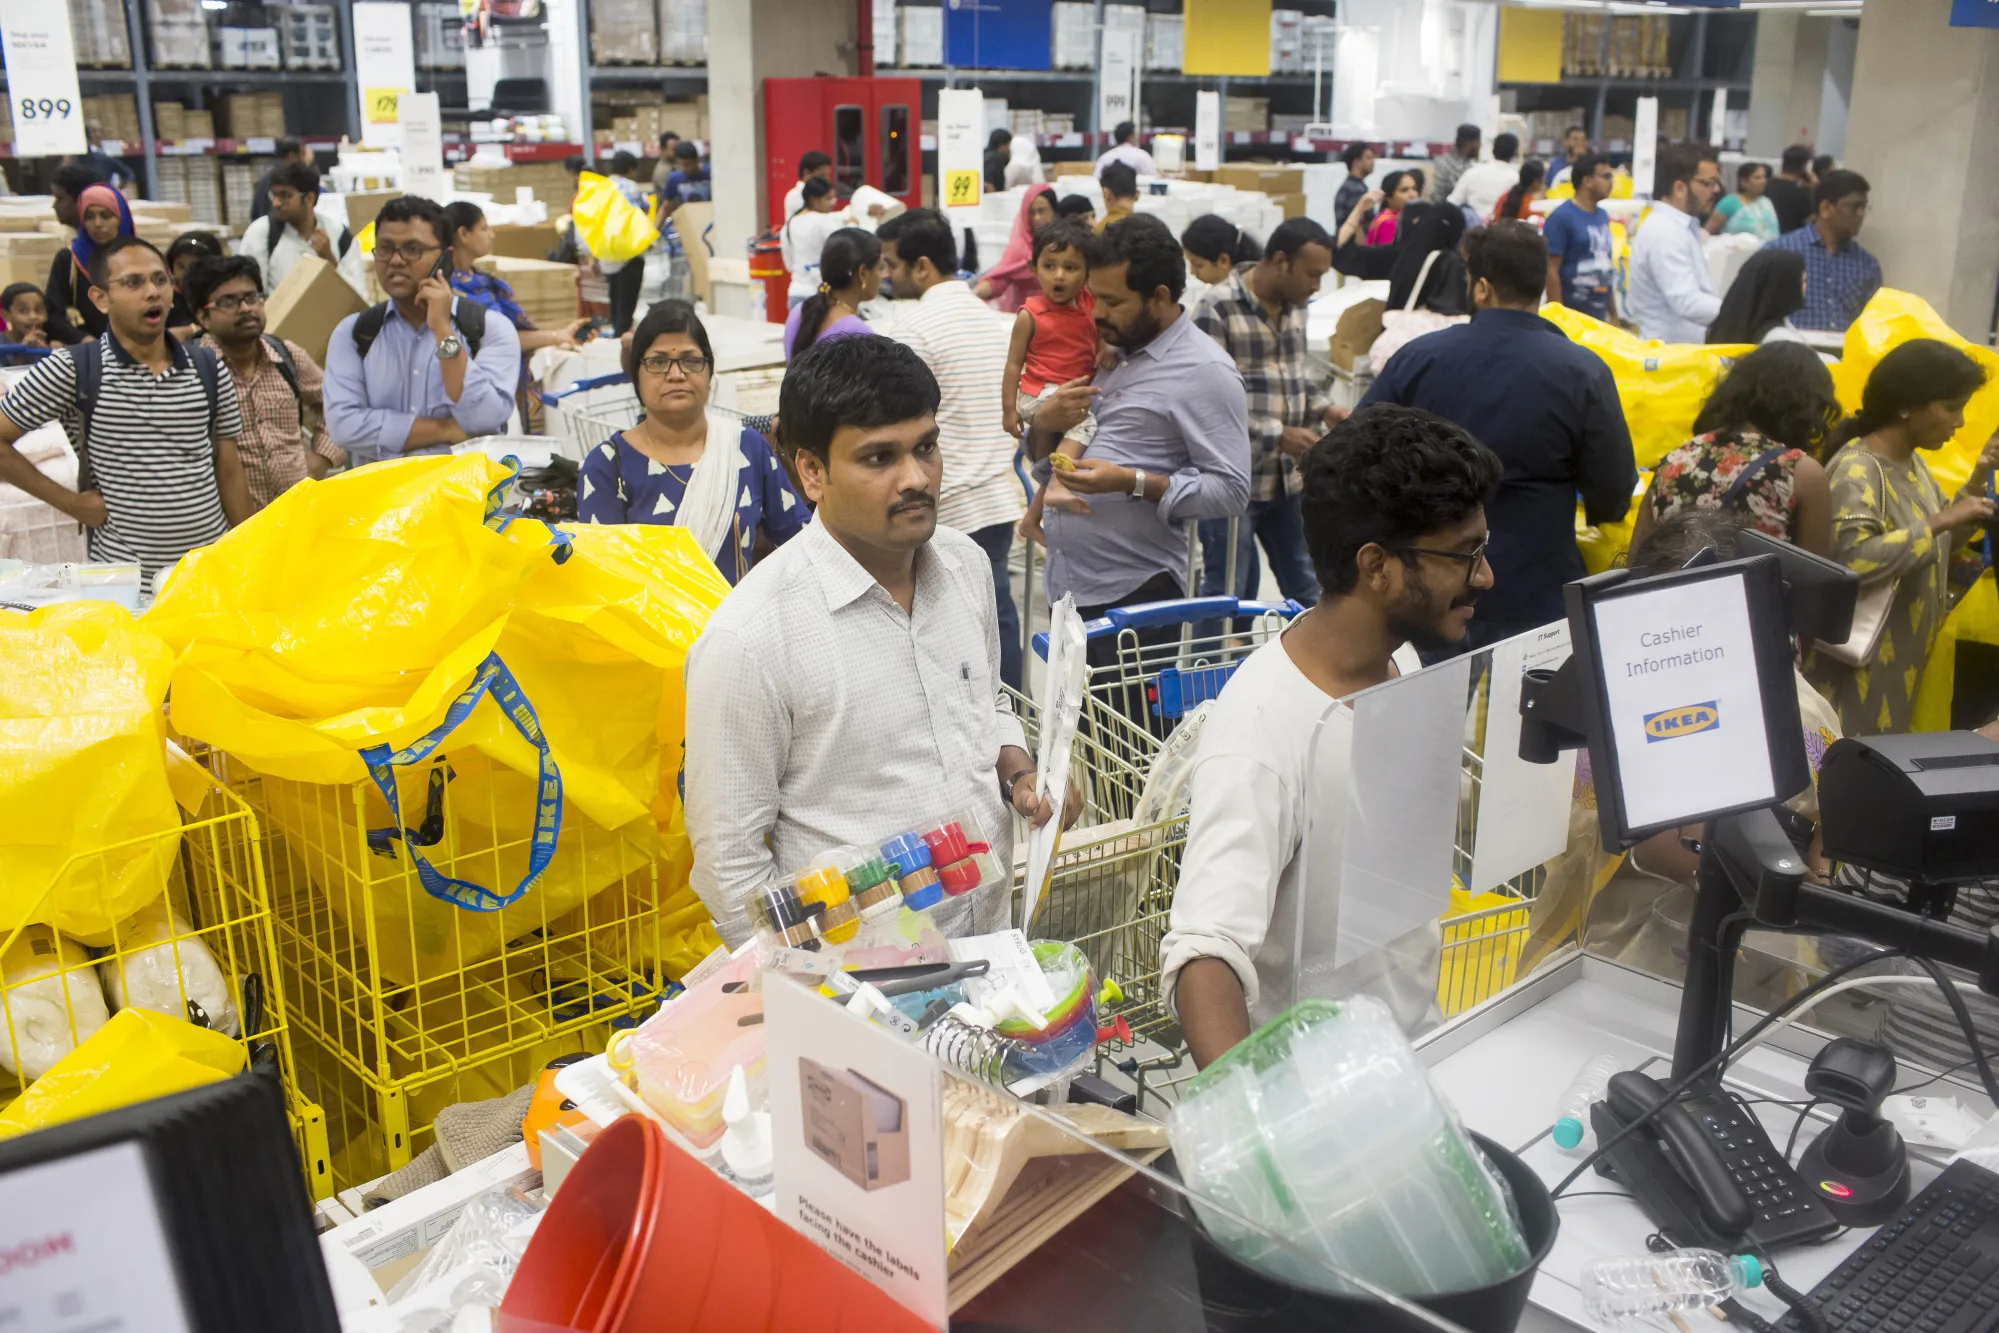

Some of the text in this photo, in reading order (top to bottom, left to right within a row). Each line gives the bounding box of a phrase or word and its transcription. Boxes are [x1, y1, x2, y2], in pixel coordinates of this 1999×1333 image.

[22, 98, 71, 119] 899
[952, 176, 970, 197] 99
[1543, 629, 1560, 639] Support
[1640, 625, 1703, 648] Cashier
[1626, 646, 1724, 677] Information
[1654, 710, 1710, 732] IKEA
[799, 1195, 832, 1223] Please
[835, 1219, 861, 1242] have
[864, 1237, 883, 1257] the
[886, 1251, 920, 1281] labels
[799, 1209, 831, 1239] facing
[834, 1232, 852, 1251] the
[855, 1248, 895, 1278] cashier
